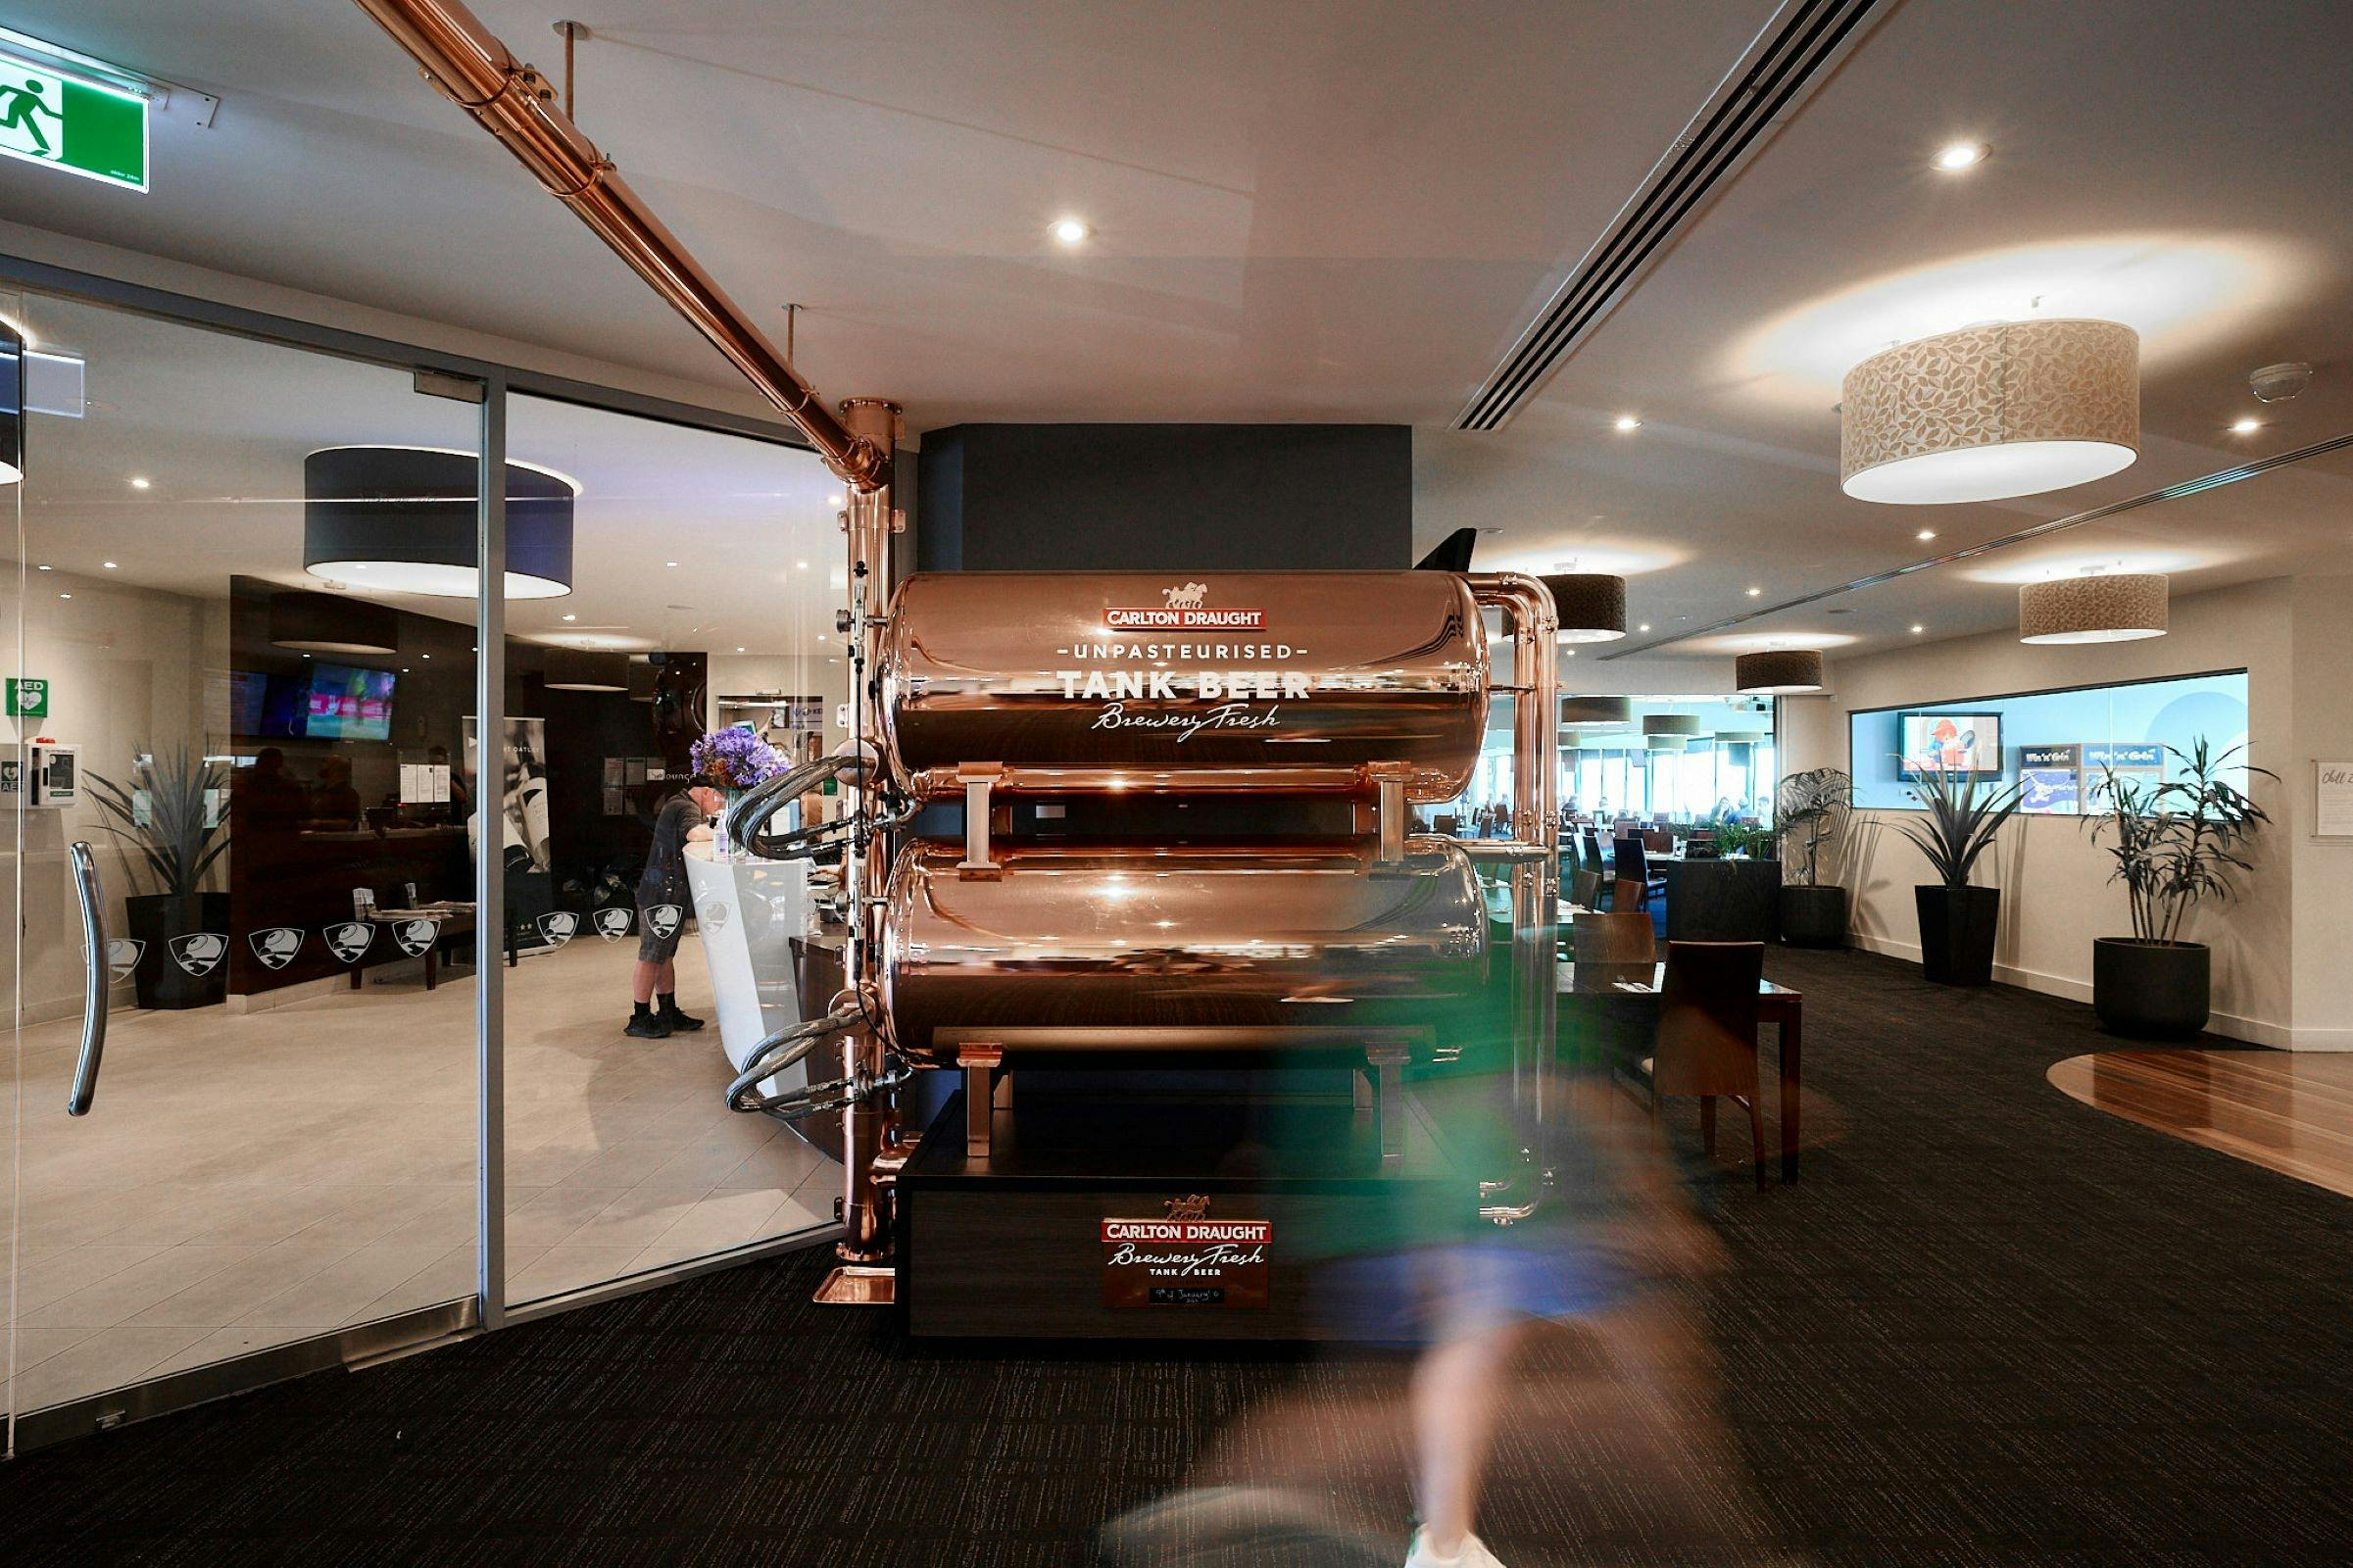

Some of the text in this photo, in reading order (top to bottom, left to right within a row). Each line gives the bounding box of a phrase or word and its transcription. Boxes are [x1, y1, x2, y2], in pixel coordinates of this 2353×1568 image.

[1106, 611, 1262, 625] CARLTON DRAUGHT
[15, 681, 44, 691] AED
[1055, 670, 1310, 699] TANK BEER
[1091, 702, 1280, 743] Brewery Fresh
[1106, 1224, 1266, 1240] CARLTON DRAUGHT
[1107, 1243, 1264, 1277] Brewery Fresh
